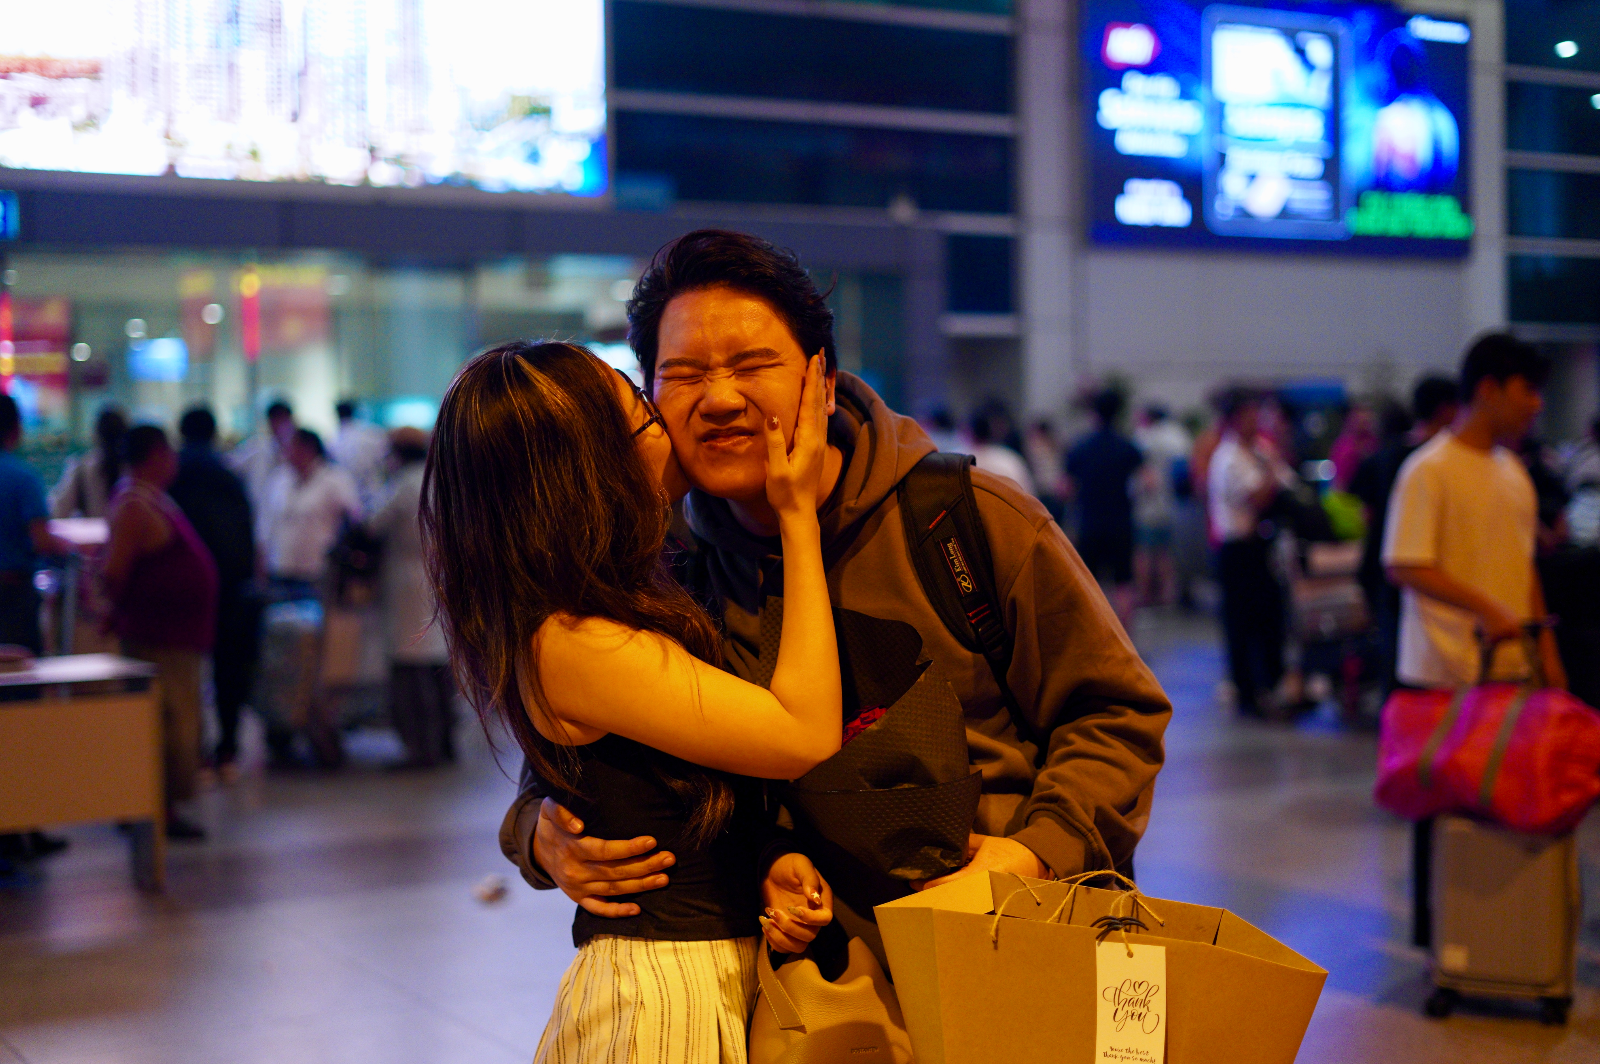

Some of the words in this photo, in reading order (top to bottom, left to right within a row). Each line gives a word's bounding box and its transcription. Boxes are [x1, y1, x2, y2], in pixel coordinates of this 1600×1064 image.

[946, 542, 957, 560] Long
[953, 558, 962, 573] Kim
[1102, 978, 1160, 1012] Thank
[1120, 1054, 1131, 1062] you
